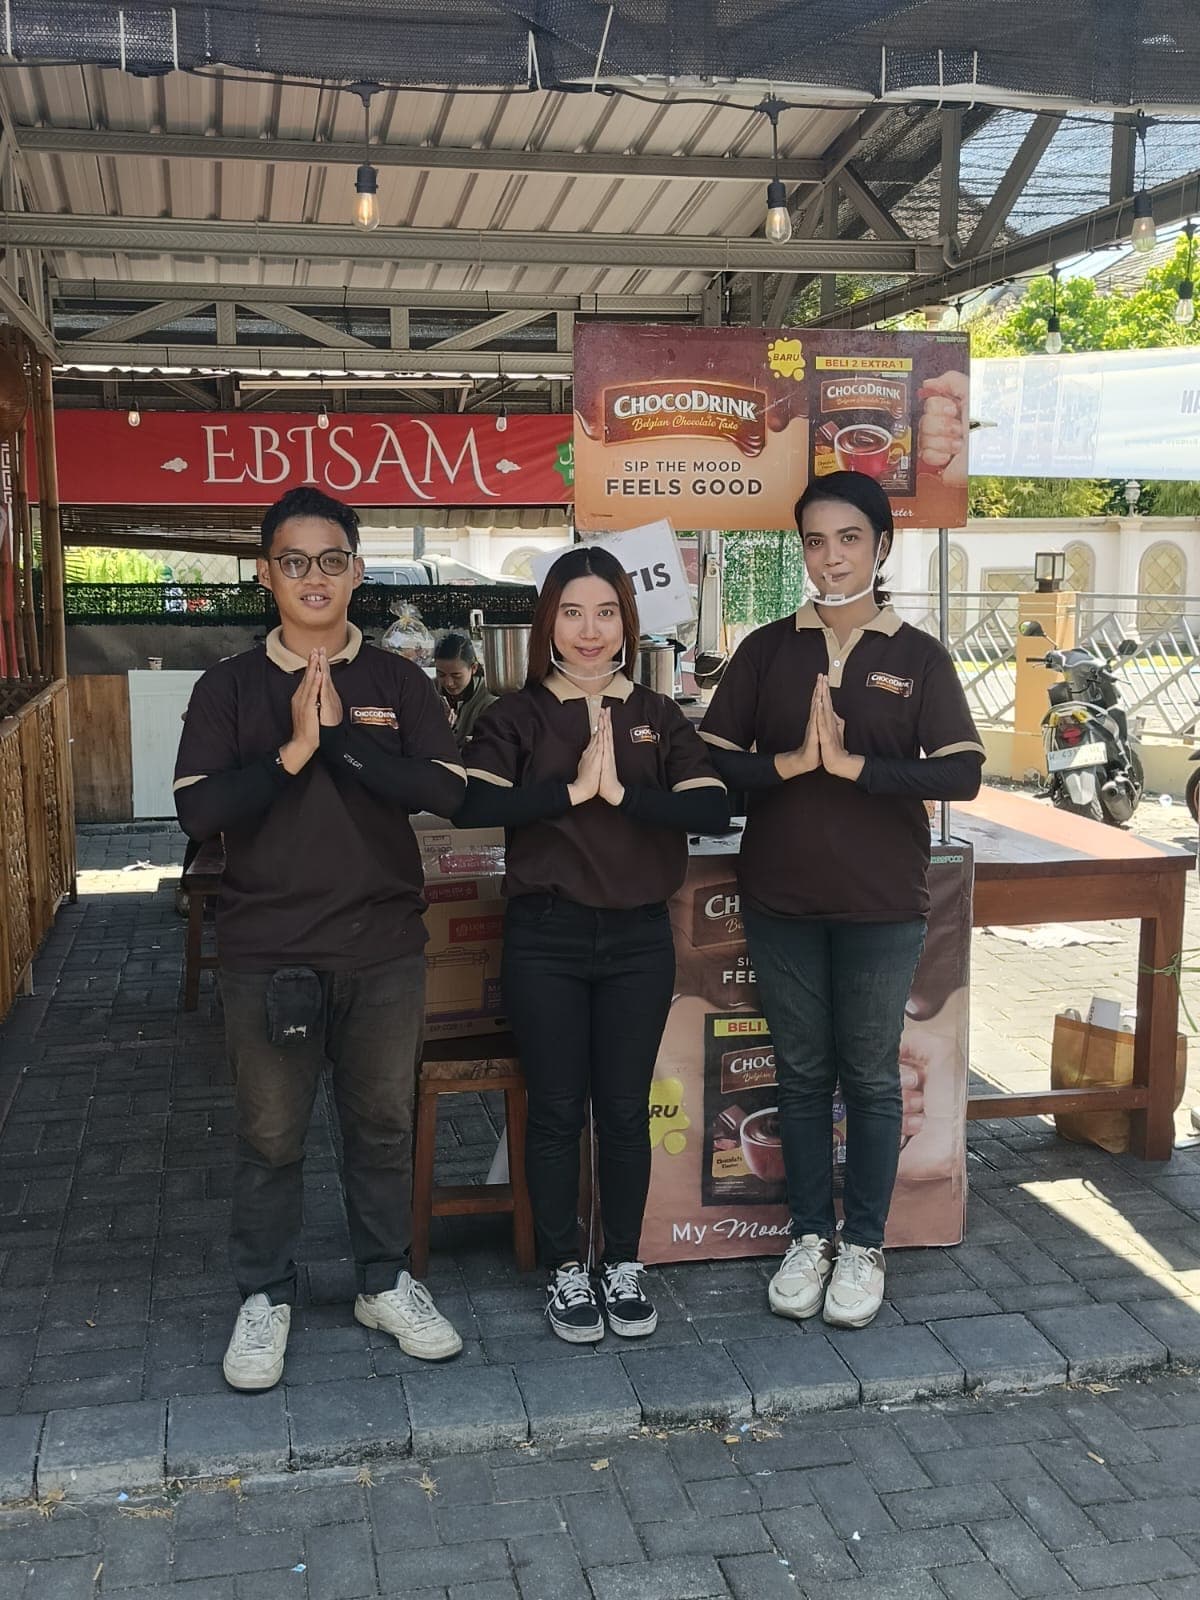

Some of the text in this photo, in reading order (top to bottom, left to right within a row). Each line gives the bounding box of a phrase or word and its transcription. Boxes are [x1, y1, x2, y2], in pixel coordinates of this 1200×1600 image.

[772, 351, 800, 362] BARU
[825, 359, 903, 369] BELI 2 EXTRA 1
[827, 382, 900, 400] CHOCODRINK
[613, 389, 759, 421] CHOCODRINK
[631, 414, 739, 432] Belgian Chocolate Taste
[624, 460, 742, 473] SIP THE MOOD
[606, 478, 763, 497] FEELS GOOD
[891, 508, 914, 517] ster
[627, 561, 671, 596] TIS
[704, 894, 740, 918] CH
[723, 971, 757, 984] FEE
[728, 1021, 762, 1033] BELI
[730, 1054, 776, 1074] CHOC
[650, 1104, 679, 1118] RU
[672, 1217, 794, 1245] My Mood
